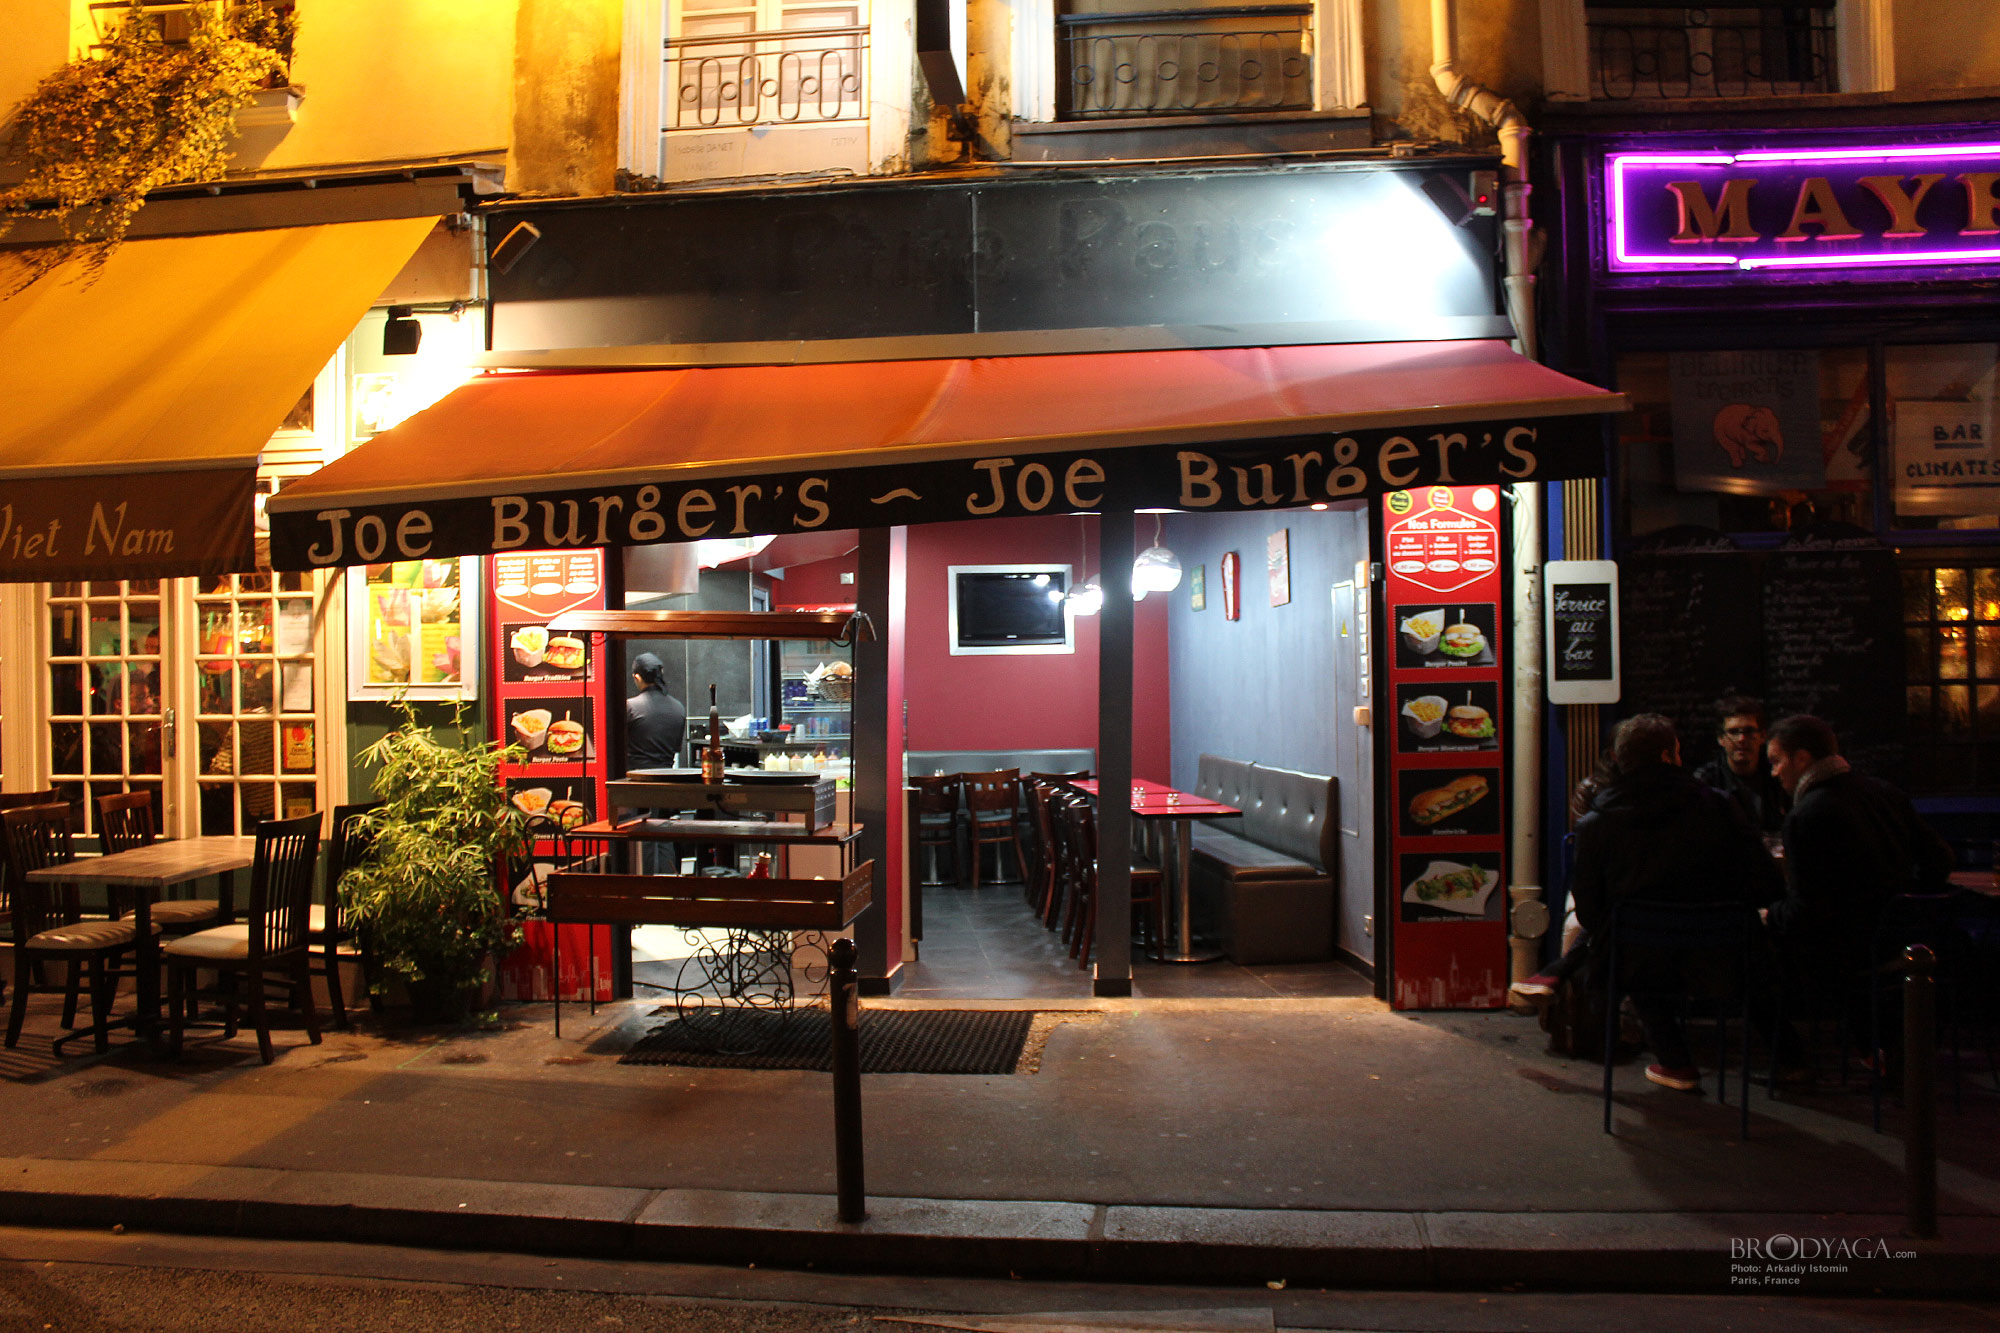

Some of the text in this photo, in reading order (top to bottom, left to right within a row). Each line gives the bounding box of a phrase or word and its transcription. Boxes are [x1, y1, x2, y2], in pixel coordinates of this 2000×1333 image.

[1933, 423, 1983, 441] BAR
[966, 425, 1539, 516] Joe Burger's
[84, 500, 175, 556] Nam
[307, 477, 831, 565] Joe Burger's
[1407, 517, 1477, 530] Nos Formules
[1554, 591, 1606, 612] Service
[1568, 621, 1595, 633] au
[1563, 638, 1593, 661] bar
